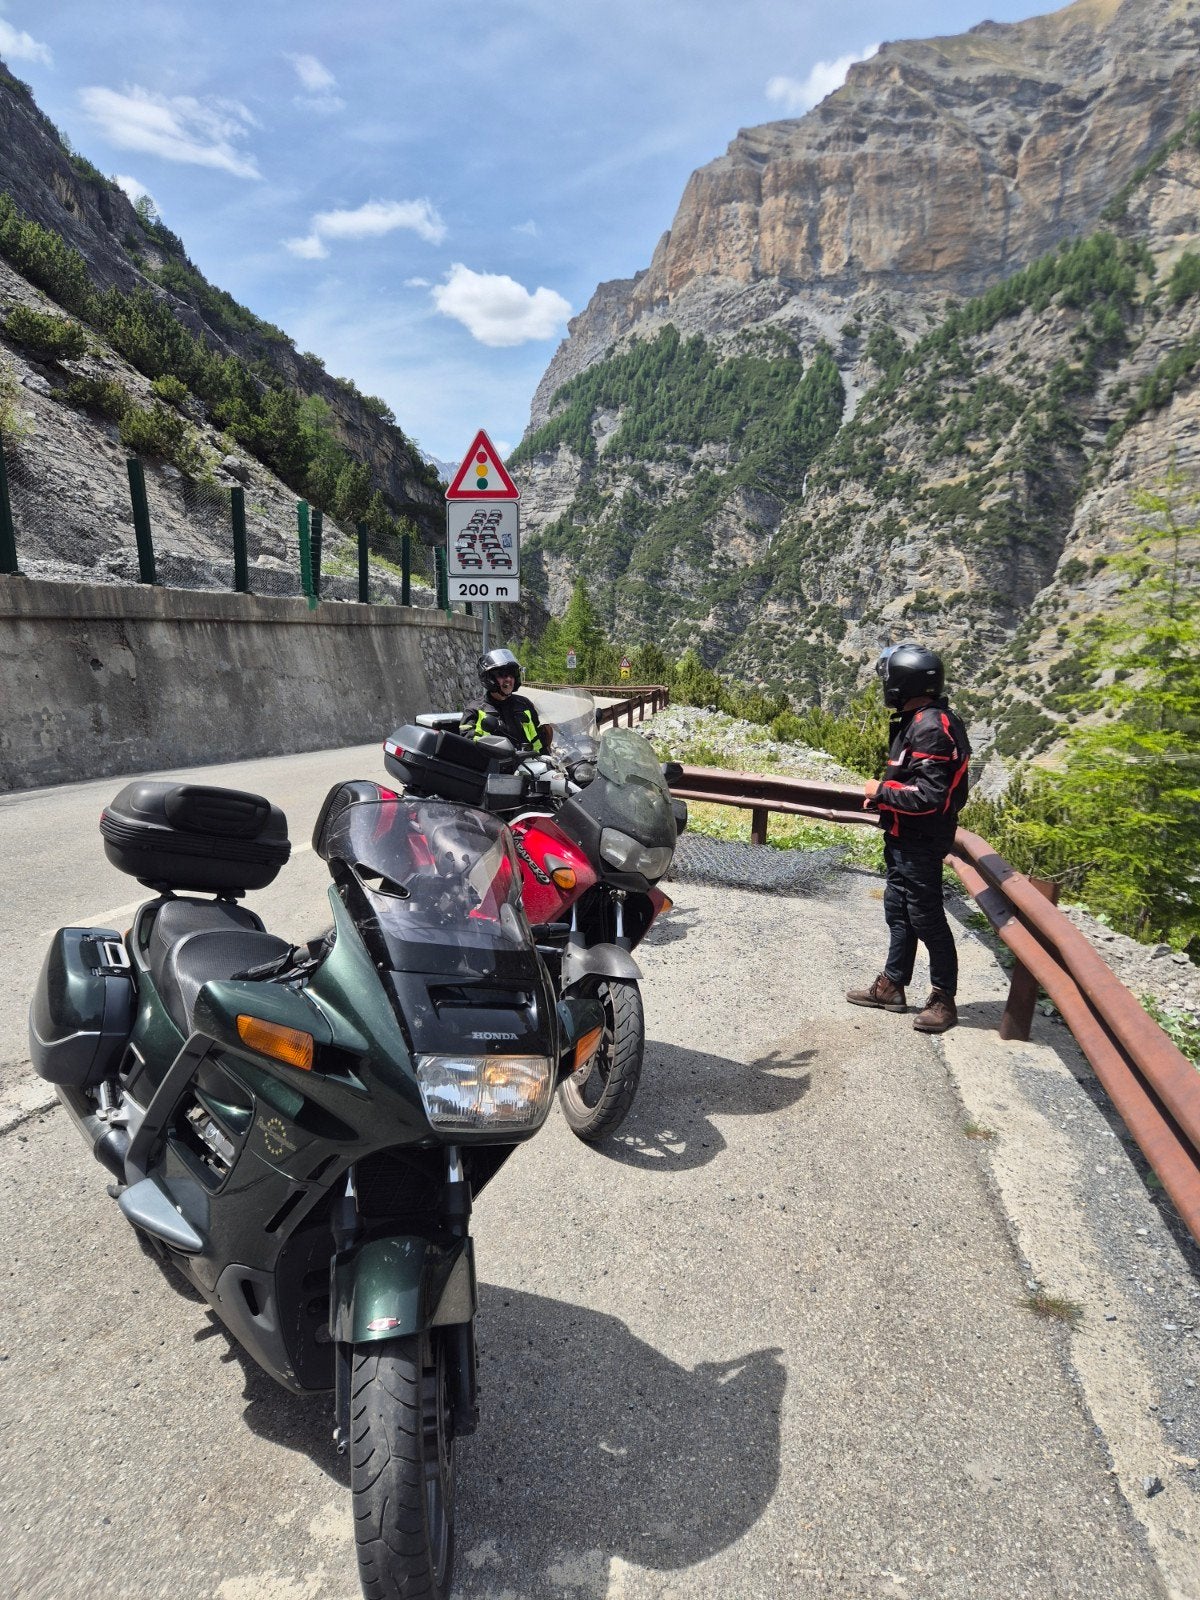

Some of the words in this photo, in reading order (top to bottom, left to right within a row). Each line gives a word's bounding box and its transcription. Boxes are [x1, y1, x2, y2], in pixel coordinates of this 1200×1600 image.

[459, 584, 489, 596] 200
[496, 586, 508, 596] m
[472, 1031, 519, 1040] HONDA
